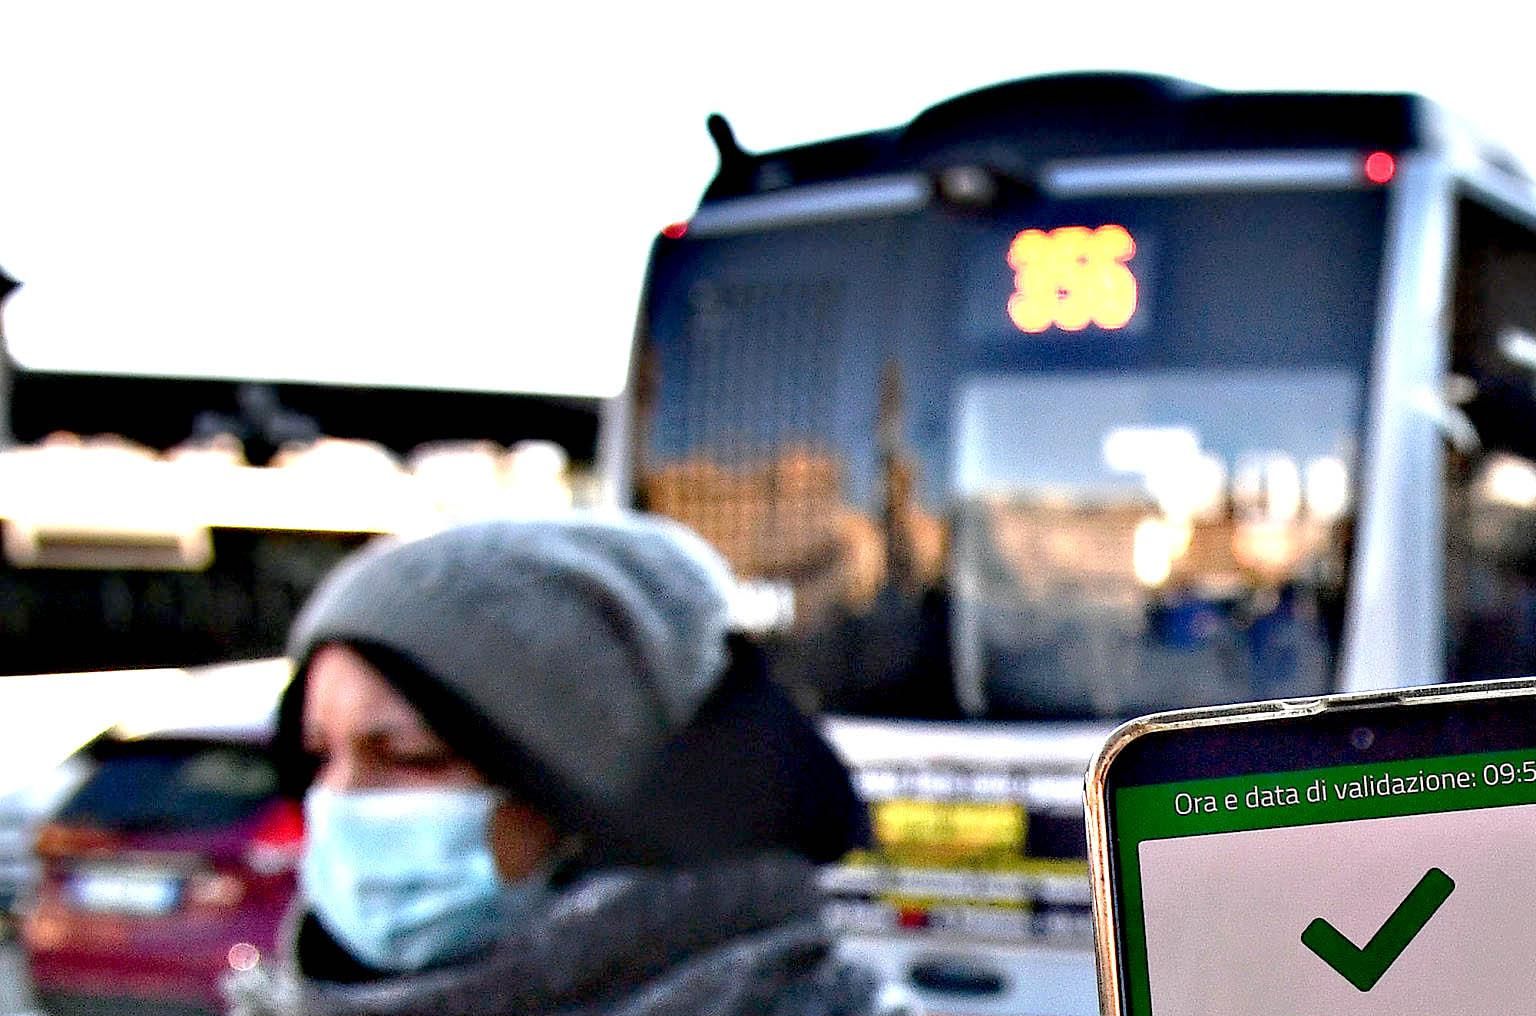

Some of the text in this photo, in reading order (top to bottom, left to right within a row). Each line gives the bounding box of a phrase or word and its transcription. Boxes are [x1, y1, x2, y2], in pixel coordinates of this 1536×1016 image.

[1174, 792, 1218, 815] Ora
[1224, 793, 1238, 811] e
[1245, 785, 1300, 809] data
[1306, 779, 1327, 803] di
[1334, 771, 1476, 797] validazione:
